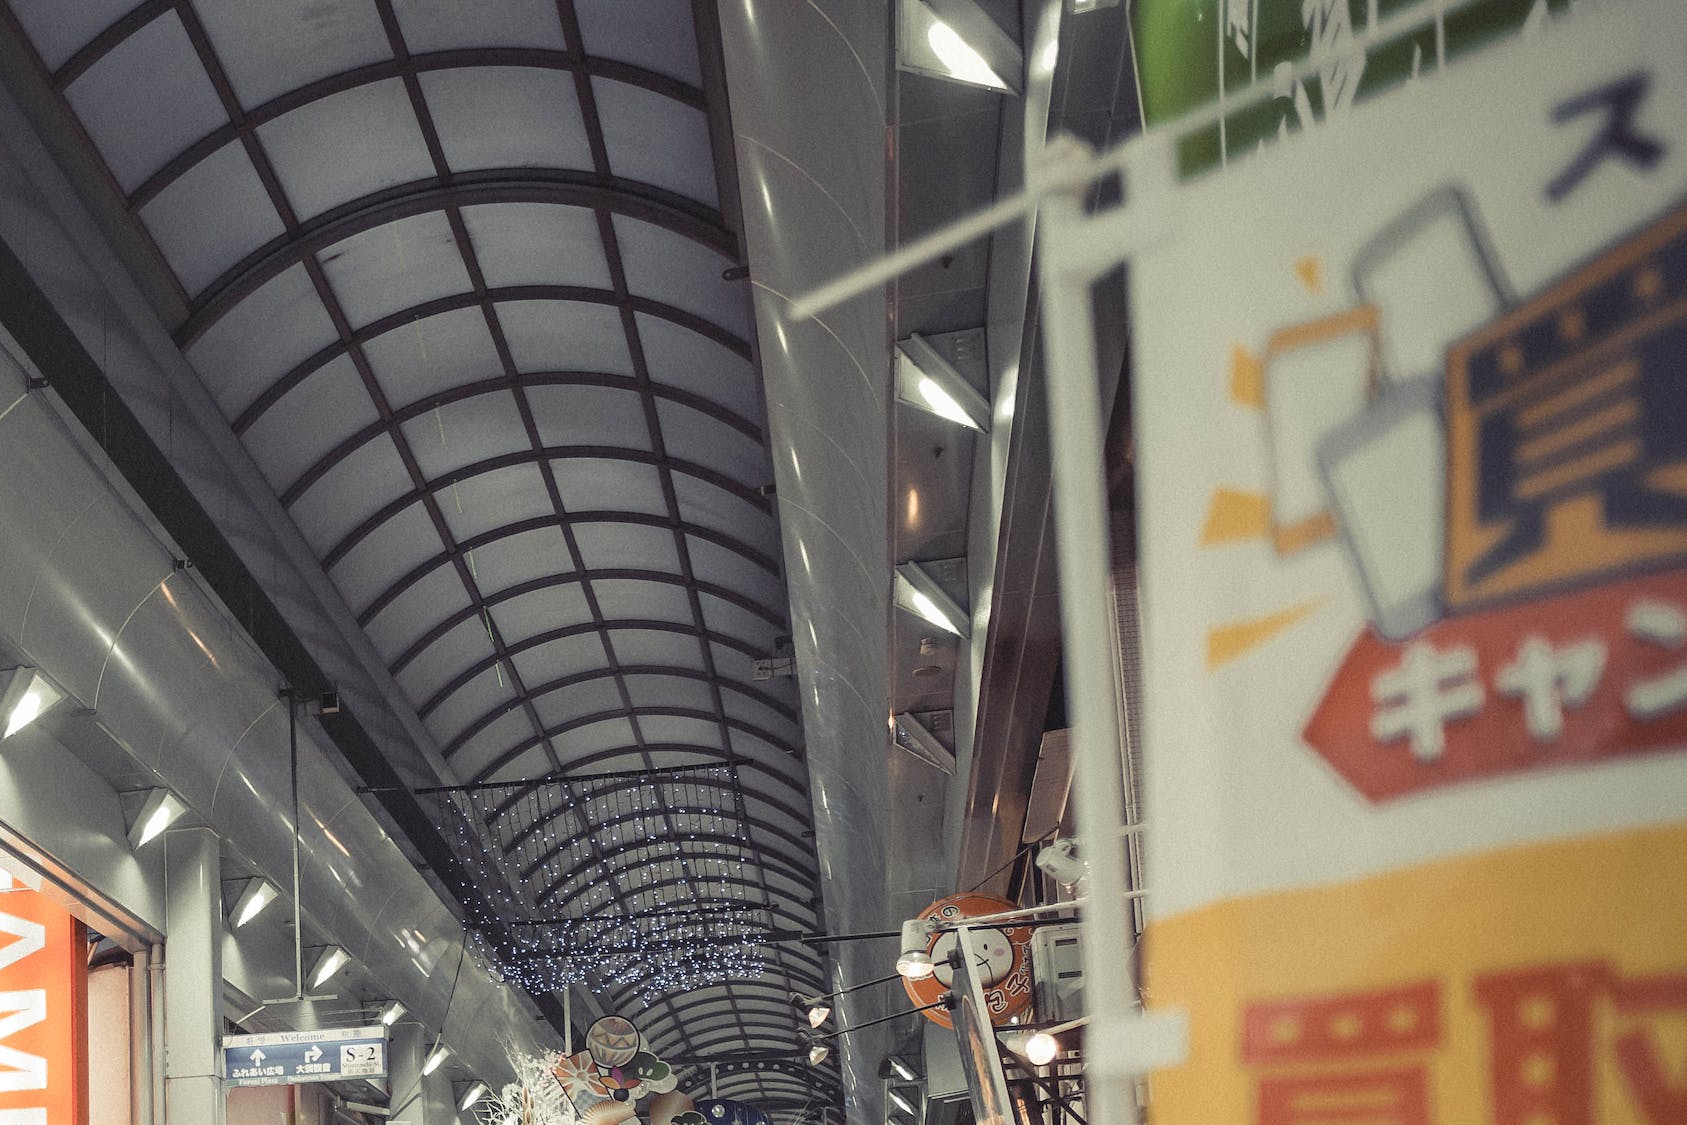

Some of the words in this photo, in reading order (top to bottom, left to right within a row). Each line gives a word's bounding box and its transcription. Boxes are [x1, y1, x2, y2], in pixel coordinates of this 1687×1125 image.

[281, 1033, 325, 1042] Welcome
[232, 1066, 284, 1078] ふれあい広場
